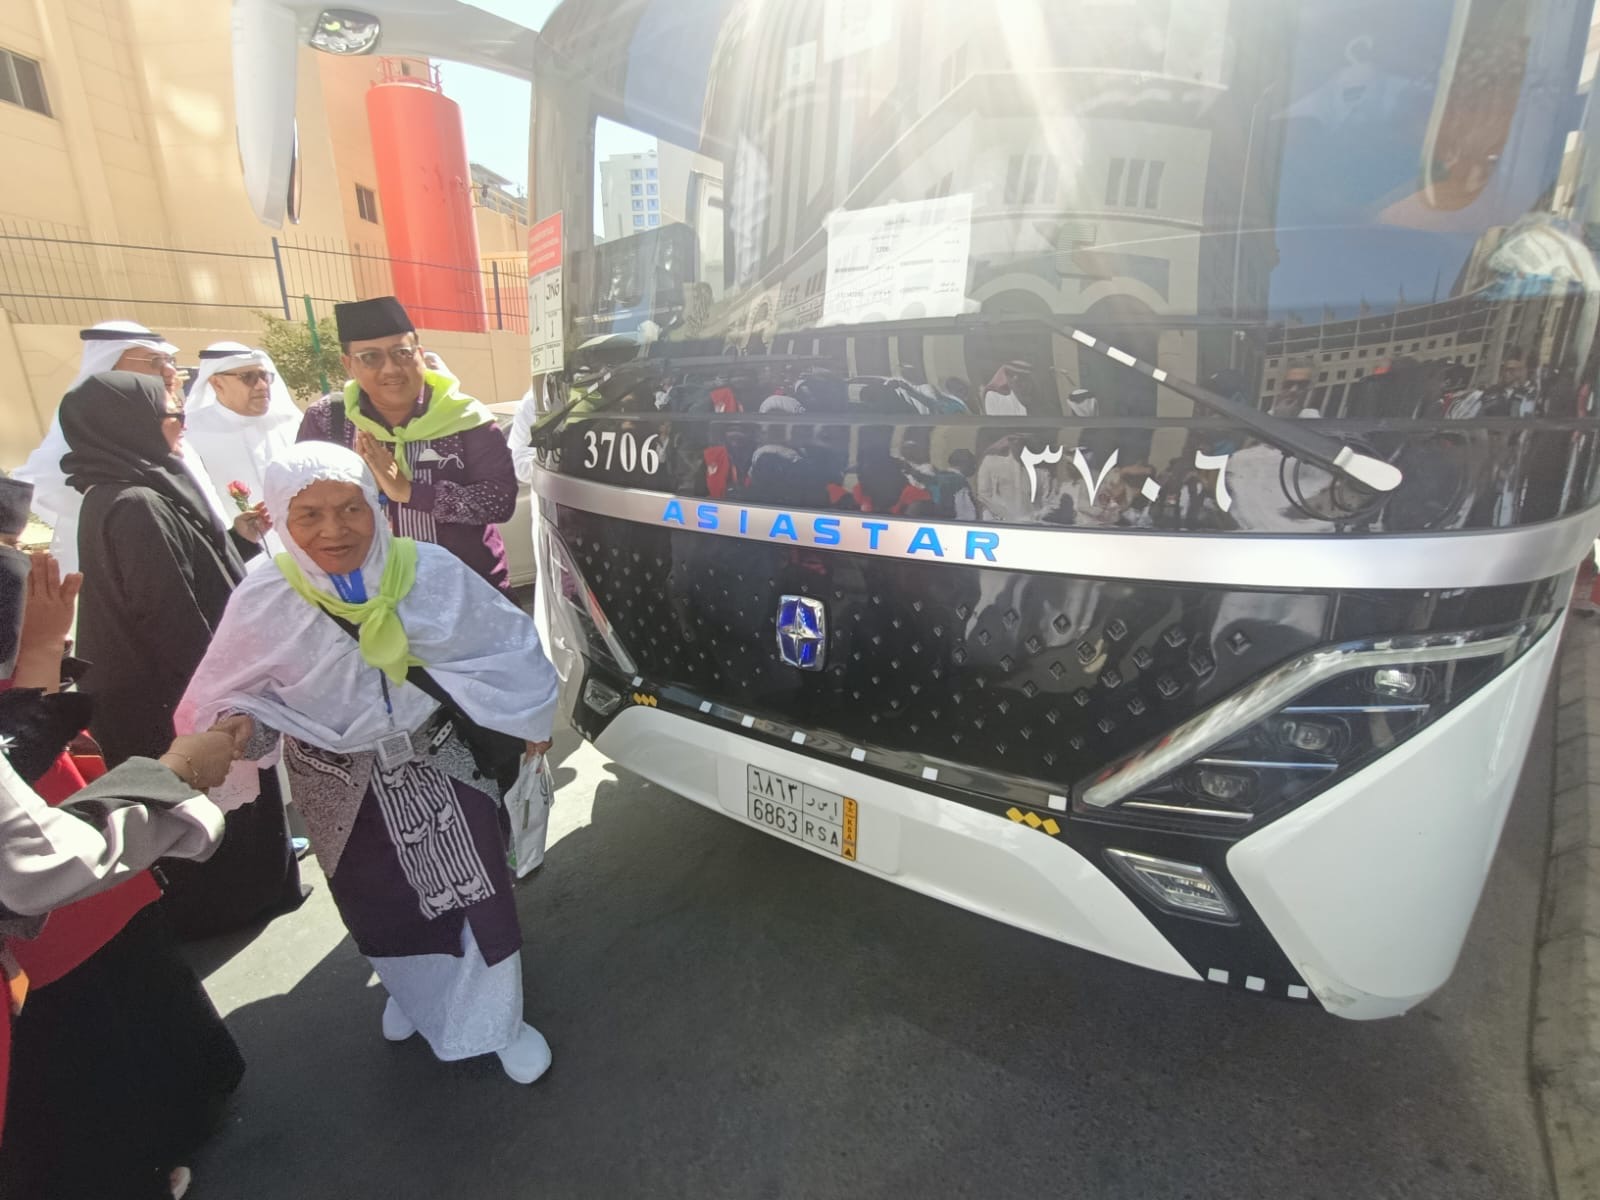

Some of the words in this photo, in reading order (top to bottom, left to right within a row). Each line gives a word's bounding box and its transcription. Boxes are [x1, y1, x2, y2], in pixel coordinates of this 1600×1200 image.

[583, 430, 660, 475] 3706
[661, 499, 1000, 562] ASIASTAR
[753, 798, 798, 834] 6863
[805, 820, 839, 848] RSA
